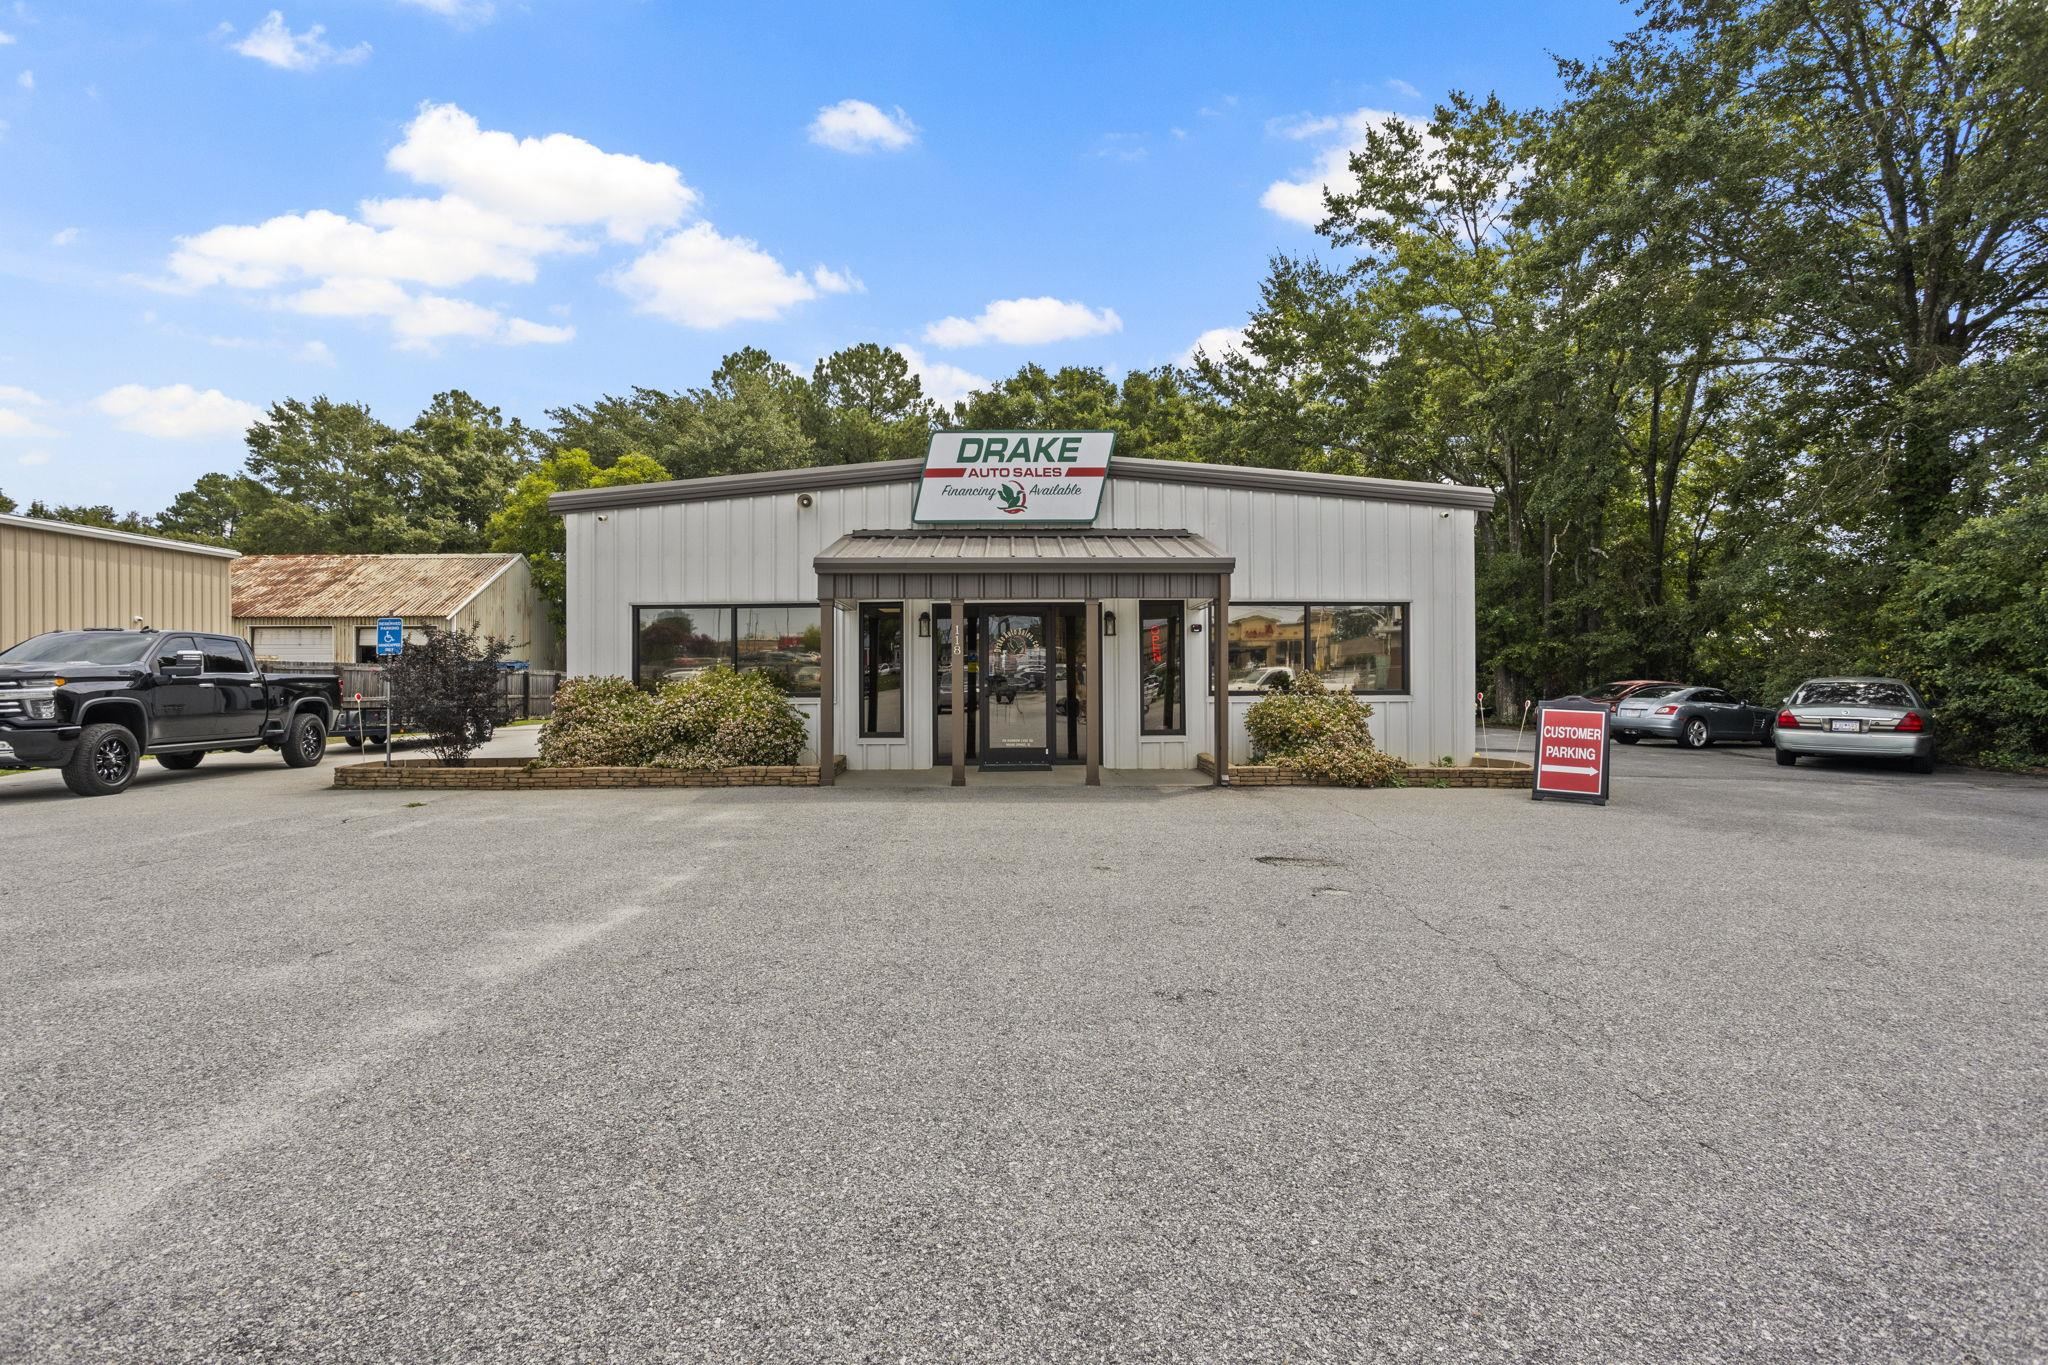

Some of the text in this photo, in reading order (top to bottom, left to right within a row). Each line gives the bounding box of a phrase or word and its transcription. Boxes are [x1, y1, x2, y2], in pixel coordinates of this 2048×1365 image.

[956, 437, 1083, 463] DRAKE
[968, 467, 1062, 478] AUTO SALES
[941, 484, 1082, 500] Financing Available
[1151, 625, 1162, 664] OPEN
[1543, 725, 1602, 740] CUSTOMER
[1546, 745, 1596, 760] PARKING
